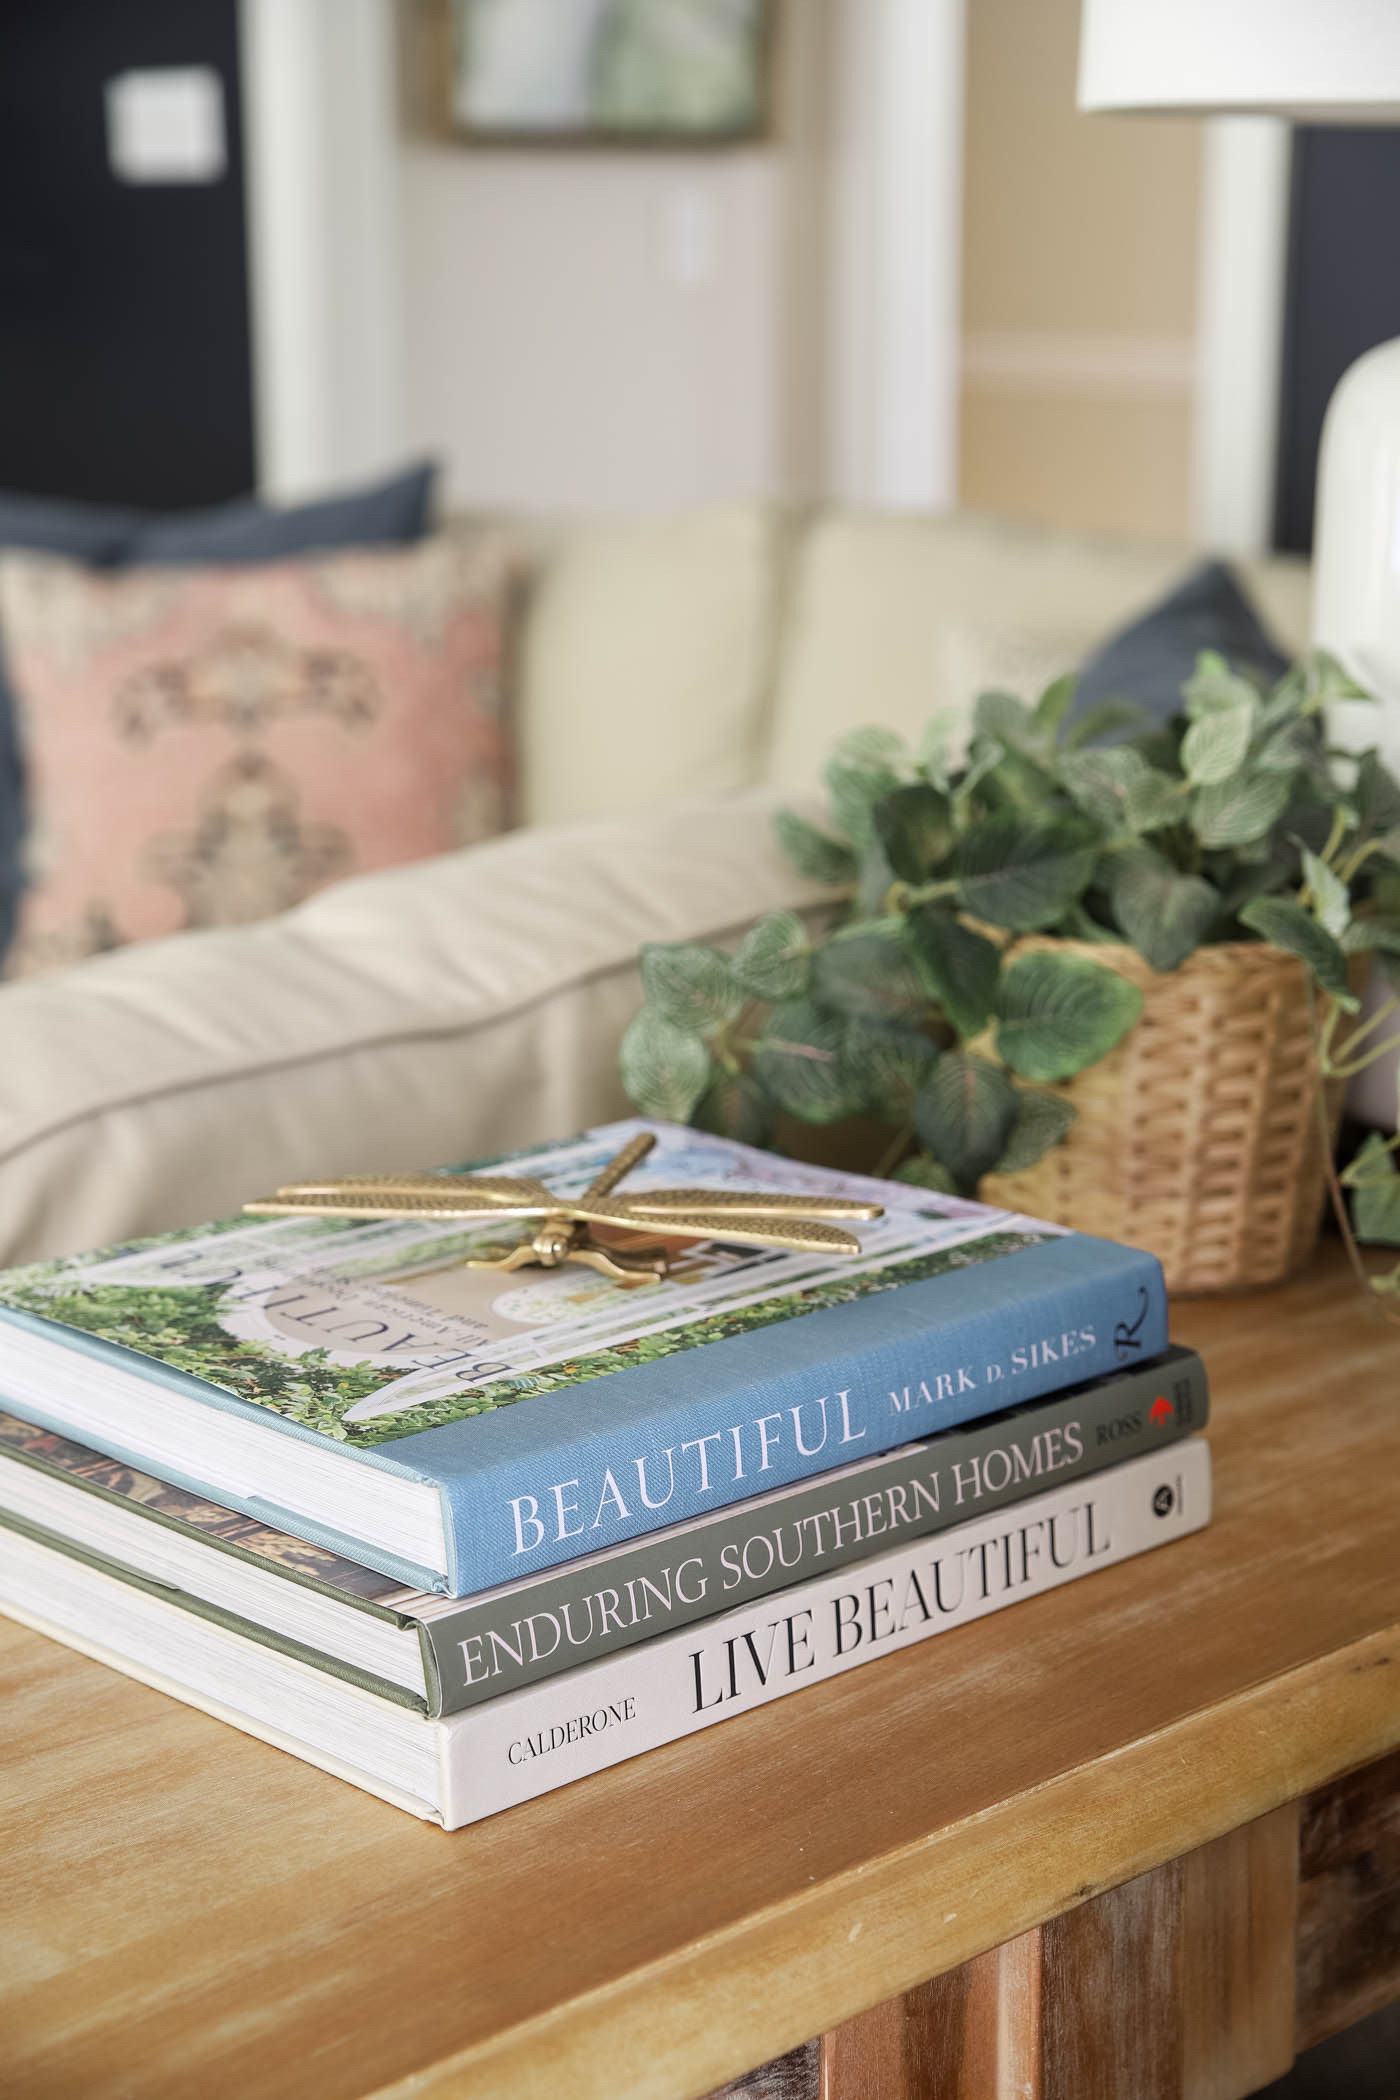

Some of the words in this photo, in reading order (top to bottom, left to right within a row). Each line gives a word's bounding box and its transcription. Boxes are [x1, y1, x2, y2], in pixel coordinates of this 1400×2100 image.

[457, 1557, 708, 1687] ENDURING
[719, 1472, 941, 1590] SOUTHERN
[951, 1420, 1085, 1506] HOMES
[1095, 1409, 1143, 1448] ROSS
[506, 1388, 867, 1556] BEAUTIFUL
[889, 1364, 977, 1417] MARK
[1011, 1324, 1097, 1375] SIKES
[507, 1696, 637, 1765] CALDERONE
[688, 1608, 816, 1714] LIVE
[830, 1501, 1112, 1659] BEAUTIFUL
